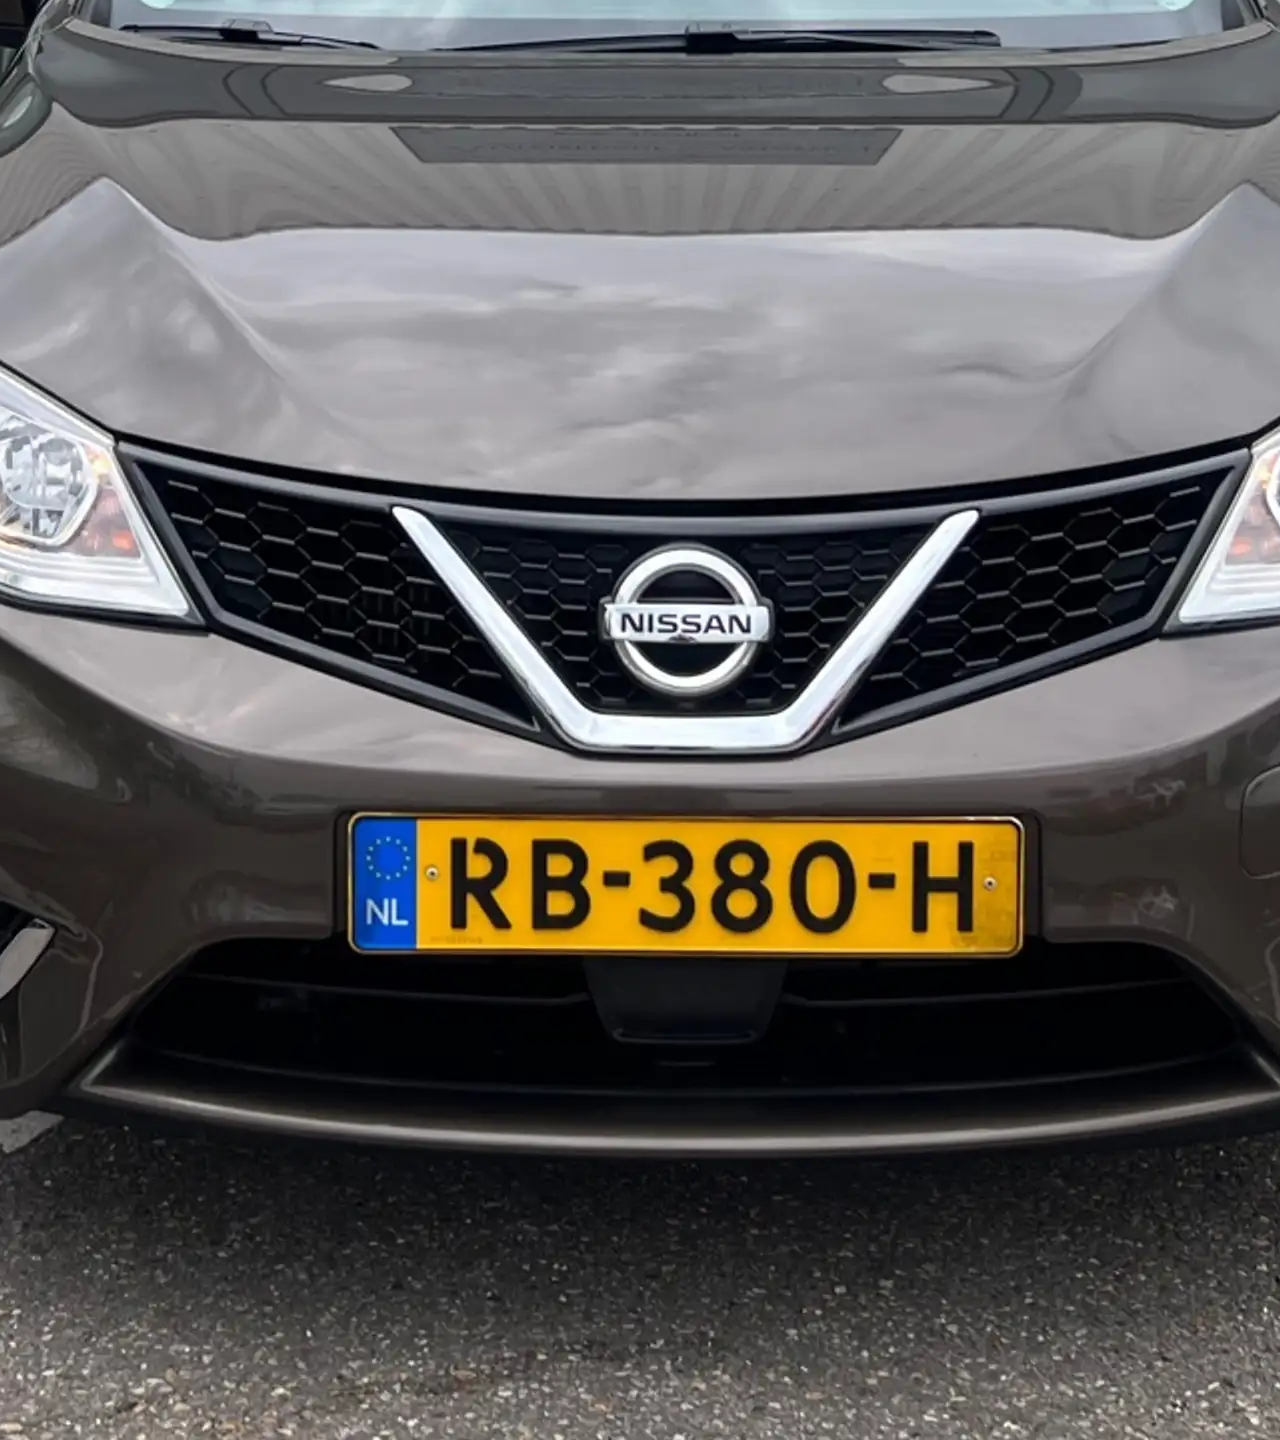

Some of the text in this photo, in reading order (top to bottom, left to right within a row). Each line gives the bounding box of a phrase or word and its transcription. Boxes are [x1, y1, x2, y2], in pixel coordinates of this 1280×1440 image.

[621, 613, 751, 634] NISSAN
[450, 837, 974, 934] RB-380-H
[366, 898, 408, 927] NL
